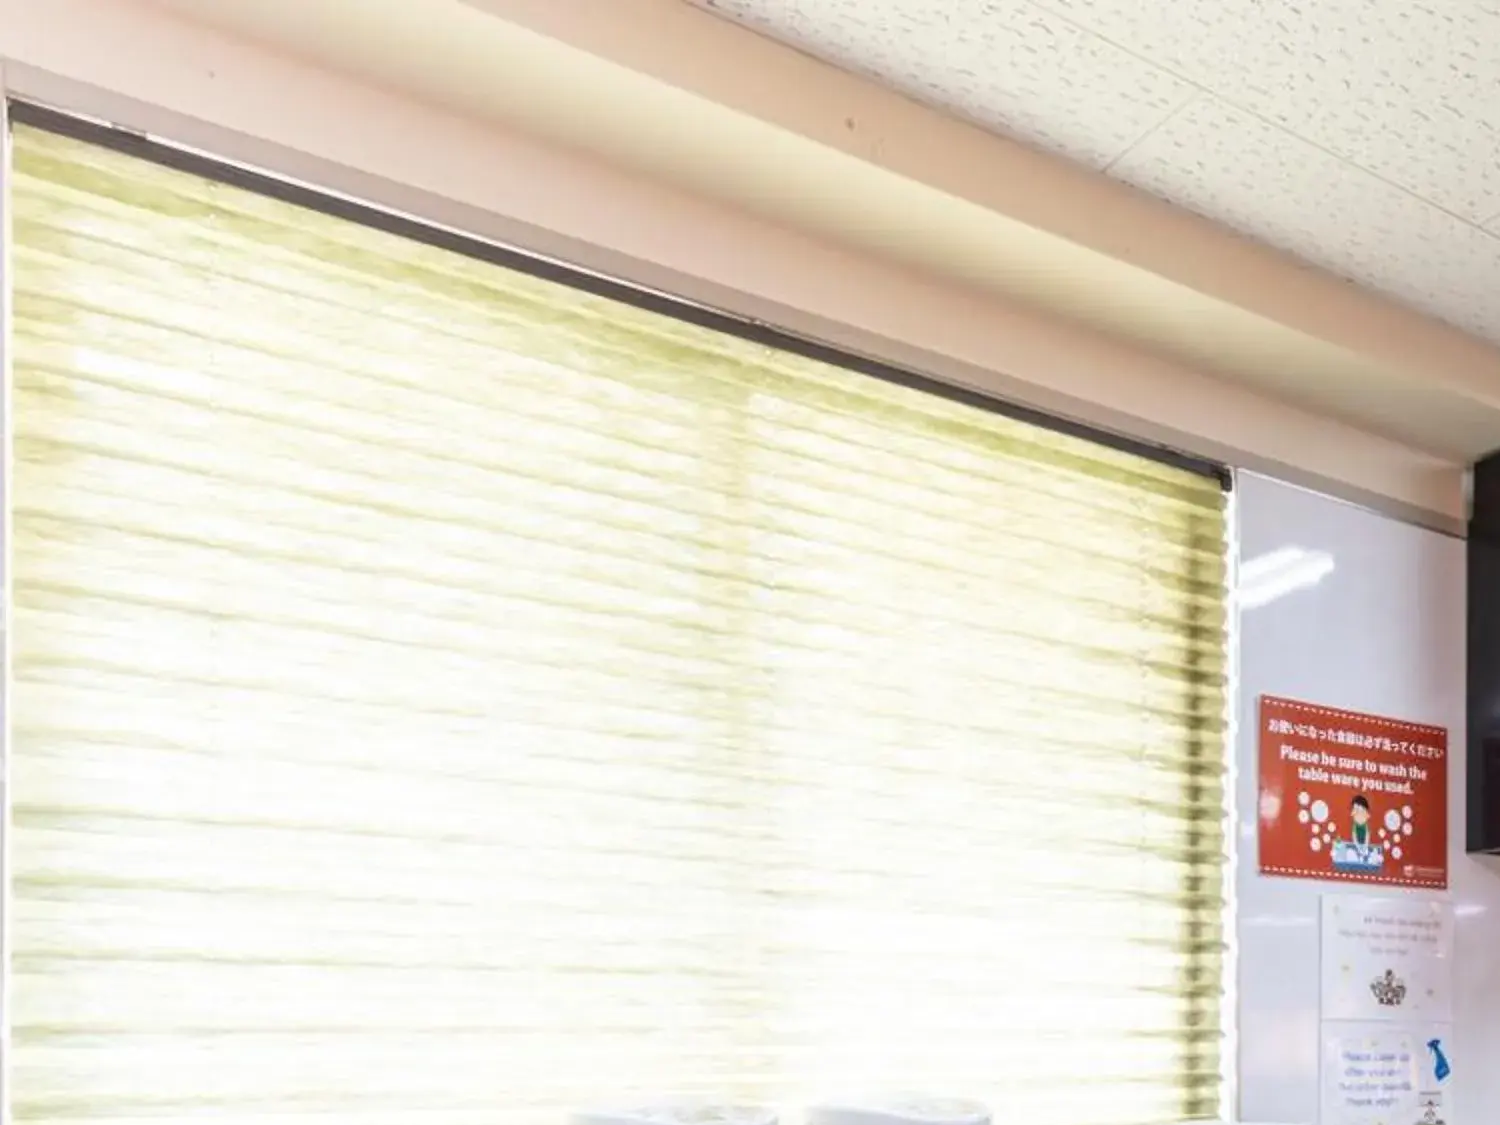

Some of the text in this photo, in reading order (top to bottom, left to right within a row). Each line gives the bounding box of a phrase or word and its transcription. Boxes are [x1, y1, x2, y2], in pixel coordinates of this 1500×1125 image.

[1280, 745, 1428, 780] Please be sure to wash the
[1298, 767, 1415, 795] table ware you used.
